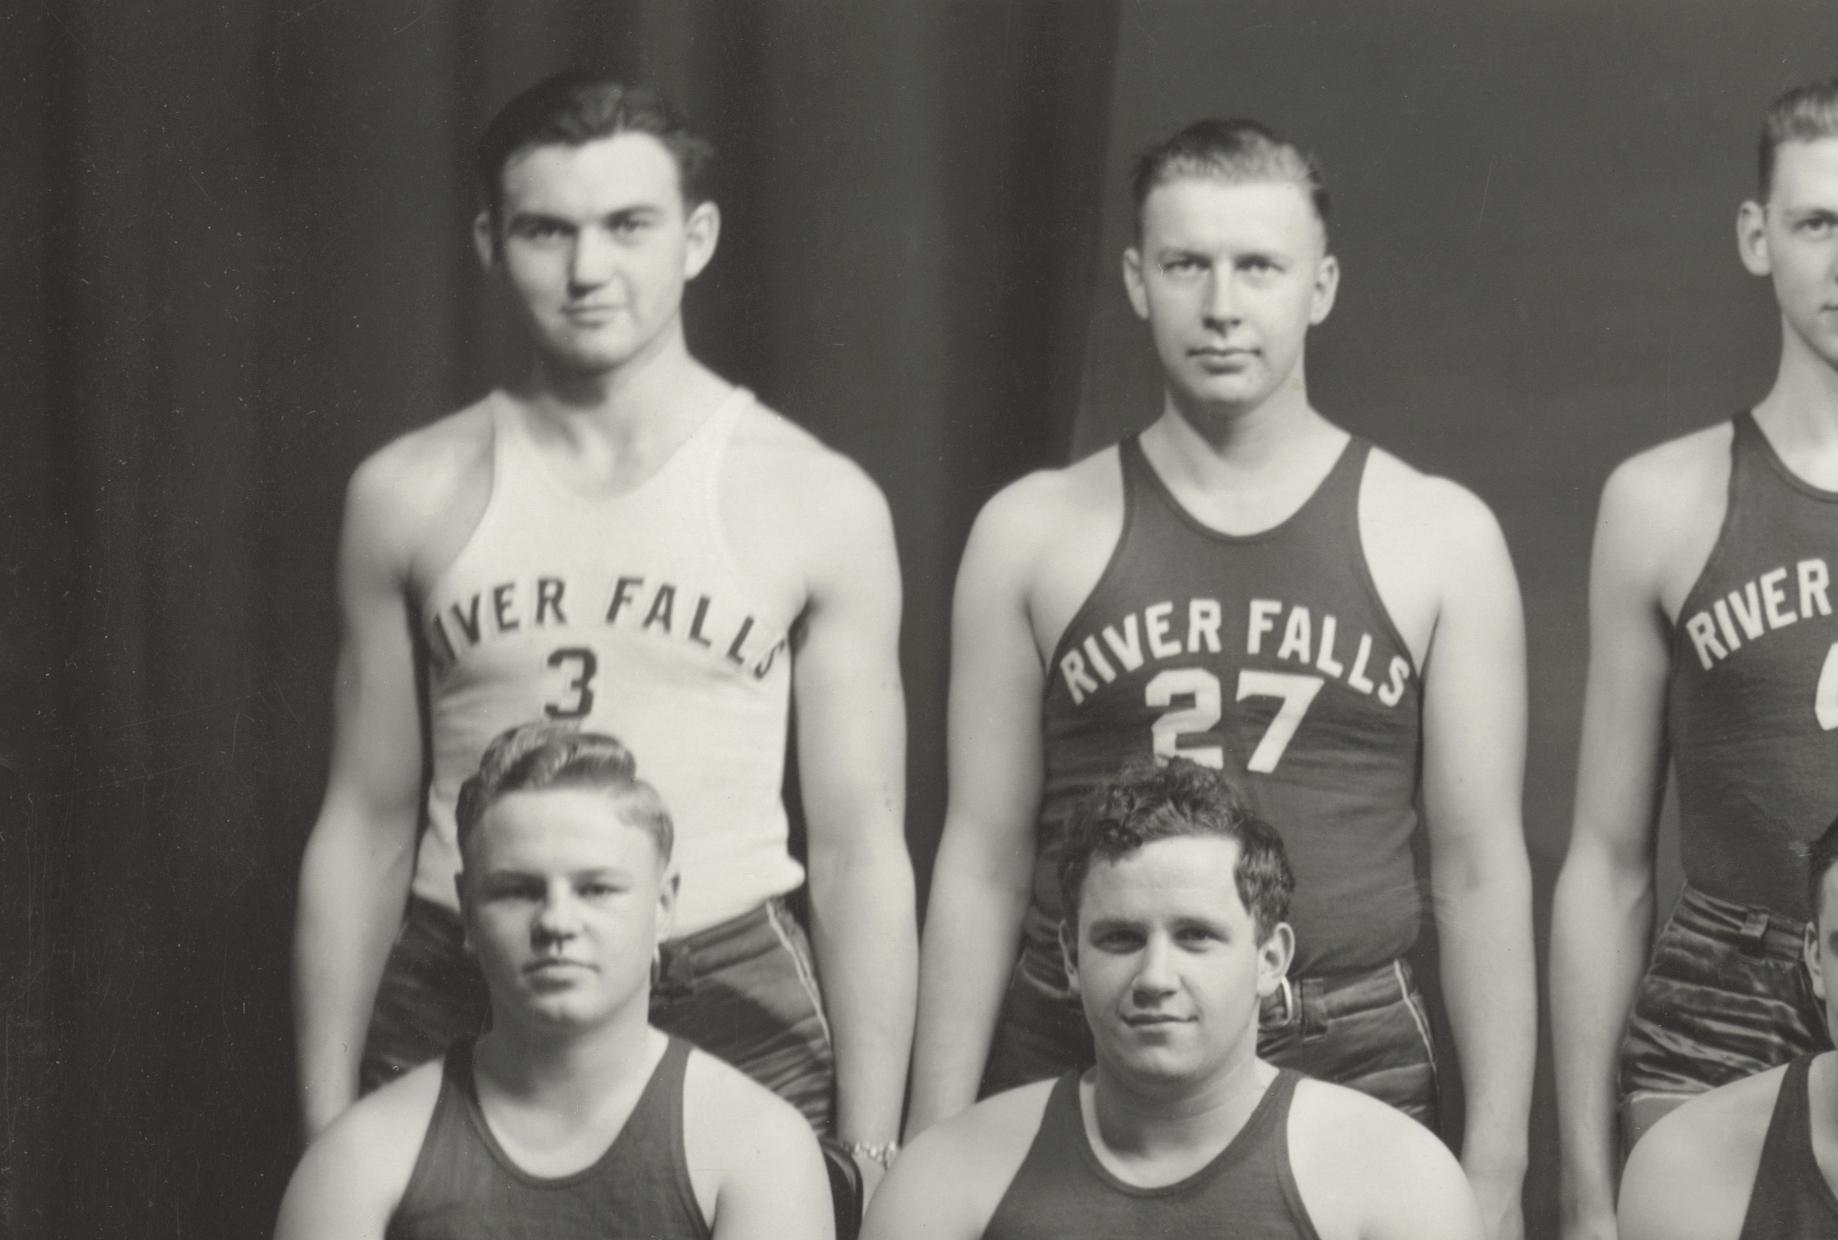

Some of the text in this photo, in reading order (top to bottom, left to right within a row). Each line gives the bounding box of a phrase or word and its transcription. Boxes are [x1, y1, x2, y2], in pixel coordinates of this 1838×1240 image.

[427, 576, 787, 684] IVER FALLS
[1059, 598, 1410, 706] RIVER FALLS
[1686, 558, 1832, 671] RIVER
[544, 647, 598, 721] 3
[1145, 667, 1324, 774] 27
